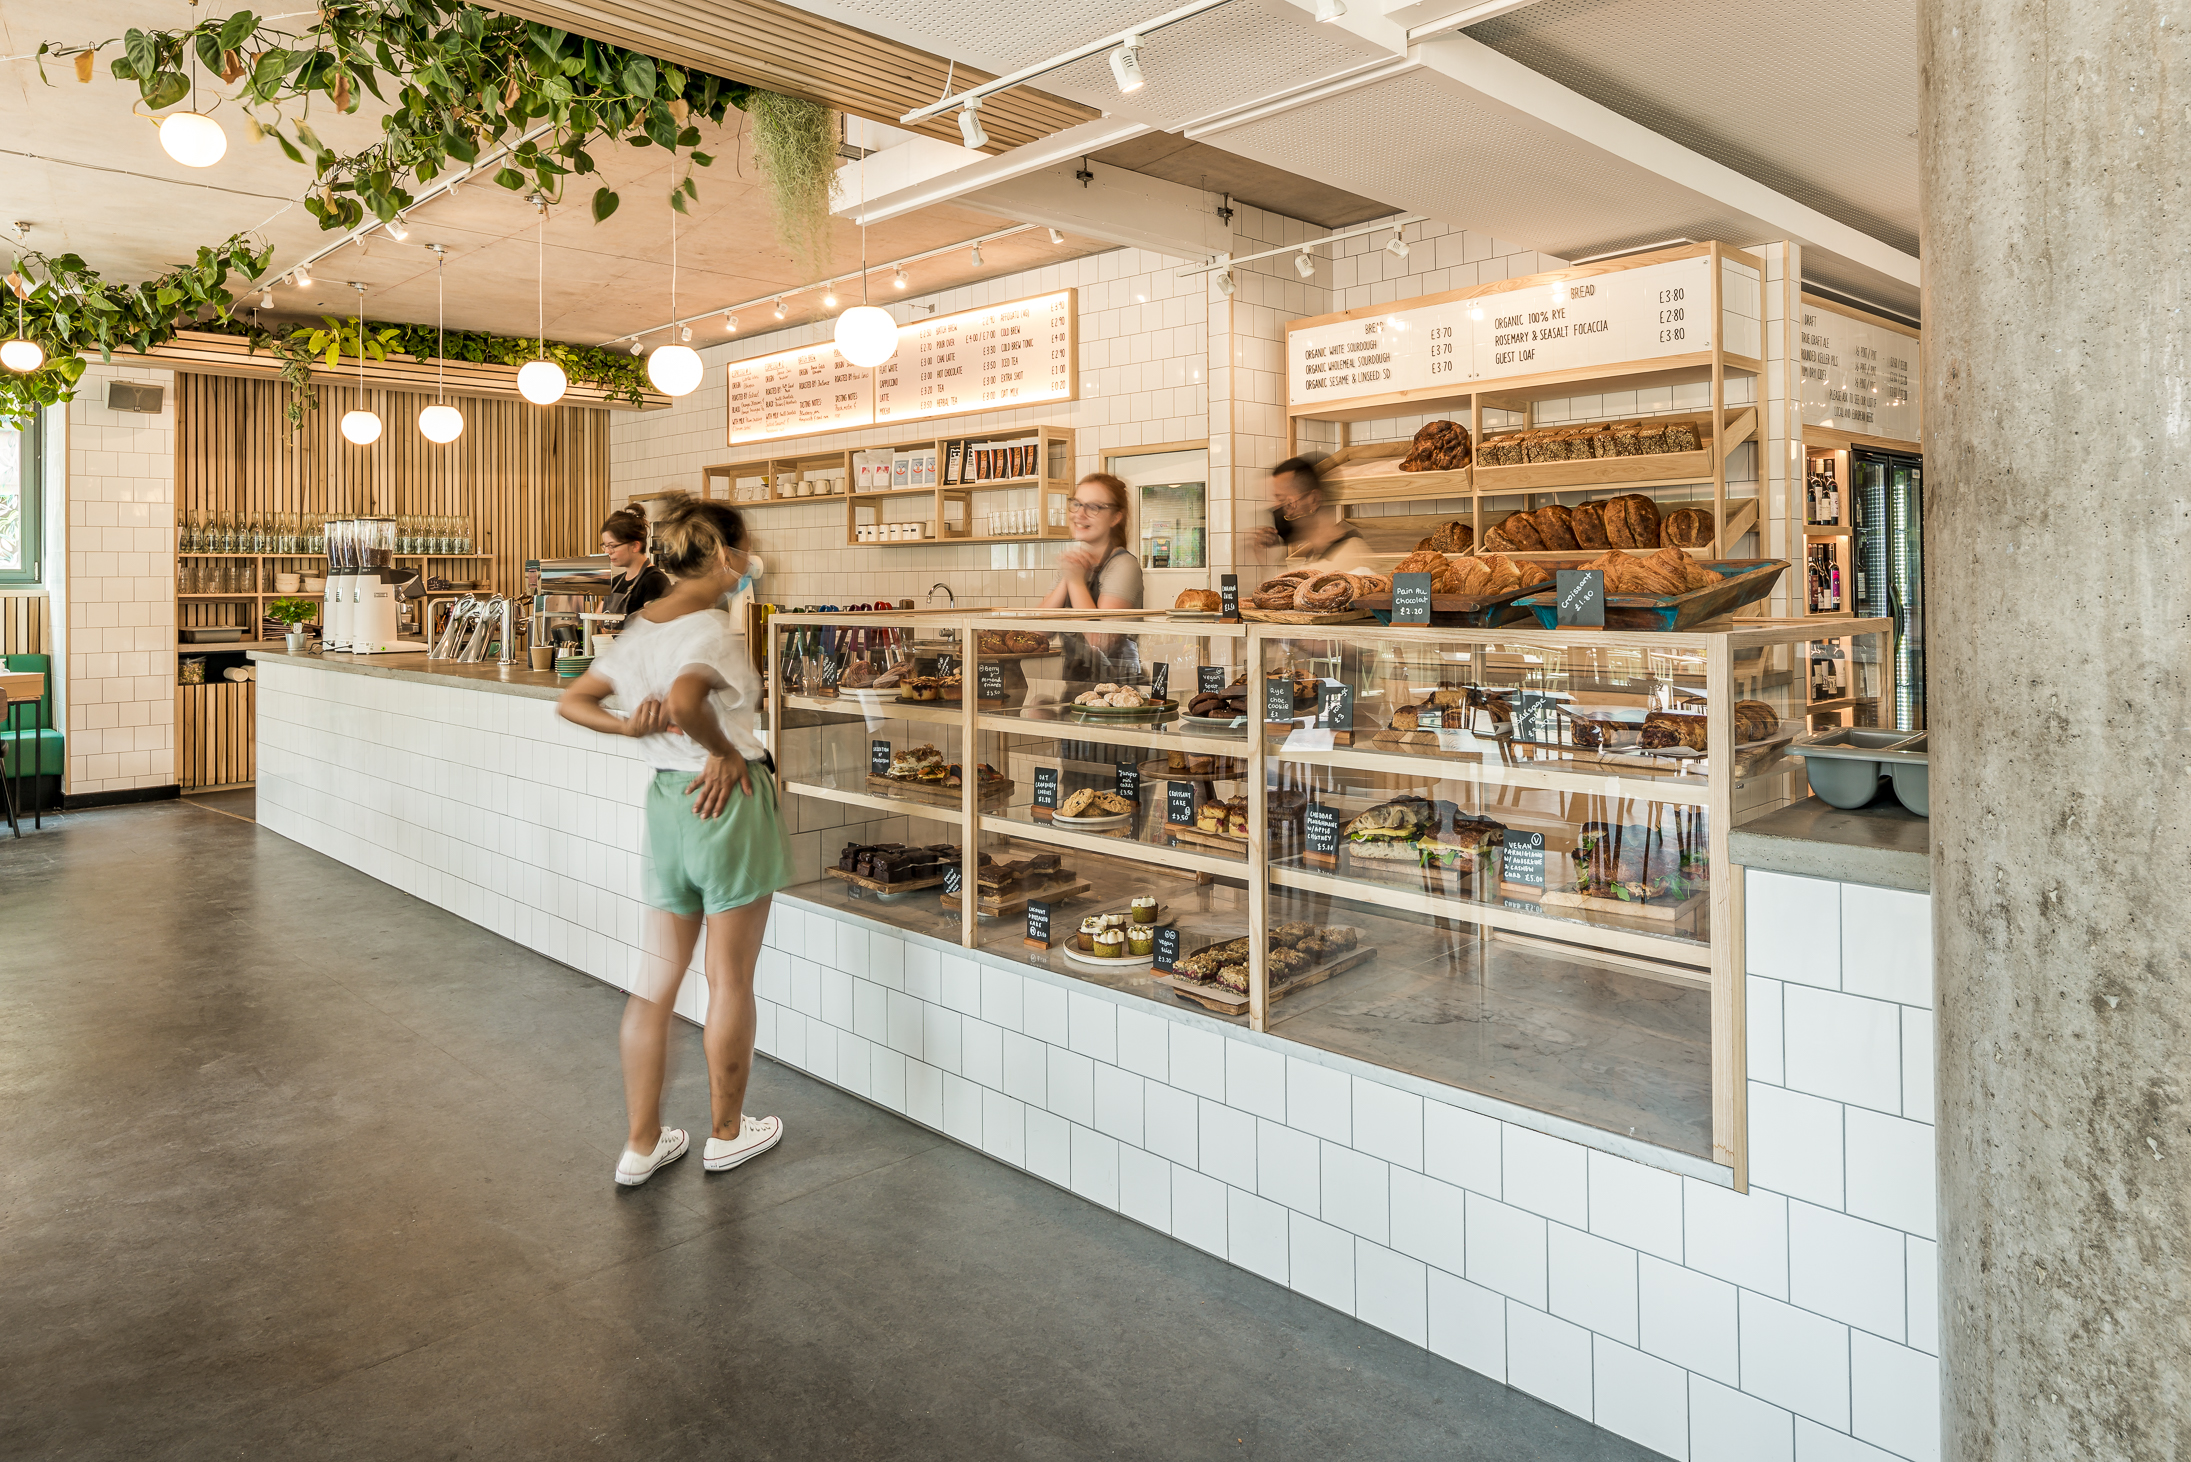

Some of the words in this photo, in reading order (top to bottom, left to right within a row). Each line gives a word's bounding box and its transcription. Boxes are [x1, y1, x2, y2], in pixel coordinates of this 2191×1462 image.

[1571, 284, 1595, 299] BREAD
[1495, 314, 1524, 330] ORGANIC
[1528, 310, 1549, 325] 100%
[1552, 308, 1566, 320] RYE
[1804, 314, 1816, 327] DRAFT
[1001, 328, 1010, 337] COLD
[1011, 326, 1020, 335] BREW
[1495, 331, 1529, 346] ROSEMARY
[1532, 330, 1538, 341] &
[1540, 326, 1569, 340] SEASALT
[1573, 320, 1608, 336] FOCACCIA
[1001, 343, 1010, 352] COLD
[1011, 341, 1021, 350] BREW
[1811, 335, 1822, 347] CRAFT
[1305, 347, 1326, 360] ORGANIC
[1329, 344, 1344, 355] WHITE
[1347, 340, 1377, 353] SOURDOUGH
[946, 352, 955, 362] LATTE
[1496, 350, 1515, 364] GUEST
[1519, 349, 1535, 362] LOAF
[1306, 361, 1326, 375] ORGANIC
[1328, 358, 1355, 371] WHOLEMEAL
[1358, 352, 1390, 367] SOURDOUGH
[944, 366, 962, 377] CHOCOLATE
[1001, 373, 1012, 383] EXTRA
[1014, 371, 1024, 380] SHOT
[1306, 376, 1327, 390] ORGANIC
[1329, 374, 1349, 387] SESAME
[1352, 373, 1356, 384] &
[1358, 370, 1380, 383] LINSEED
[1383, 369, 1391, 380] SD
[880, 393, 889, 402] LATTE
[1561, 572, 1592, 608] Croissant
[1575, 590, 1594, 611] £1.80
[1400, 607, 1423, 615] £2.20
[1334, 714, 1344, 723] £3
[1169, 790, 1191, 798] CROISSANT
[1310, 811, 1332, 819] CHEDDAR
[1509, 842, 1532, 850] VEGAN
[1504, 848, 1542, 858] PARMIGIANO
[1525, 874, 1543, 882] £5.00
